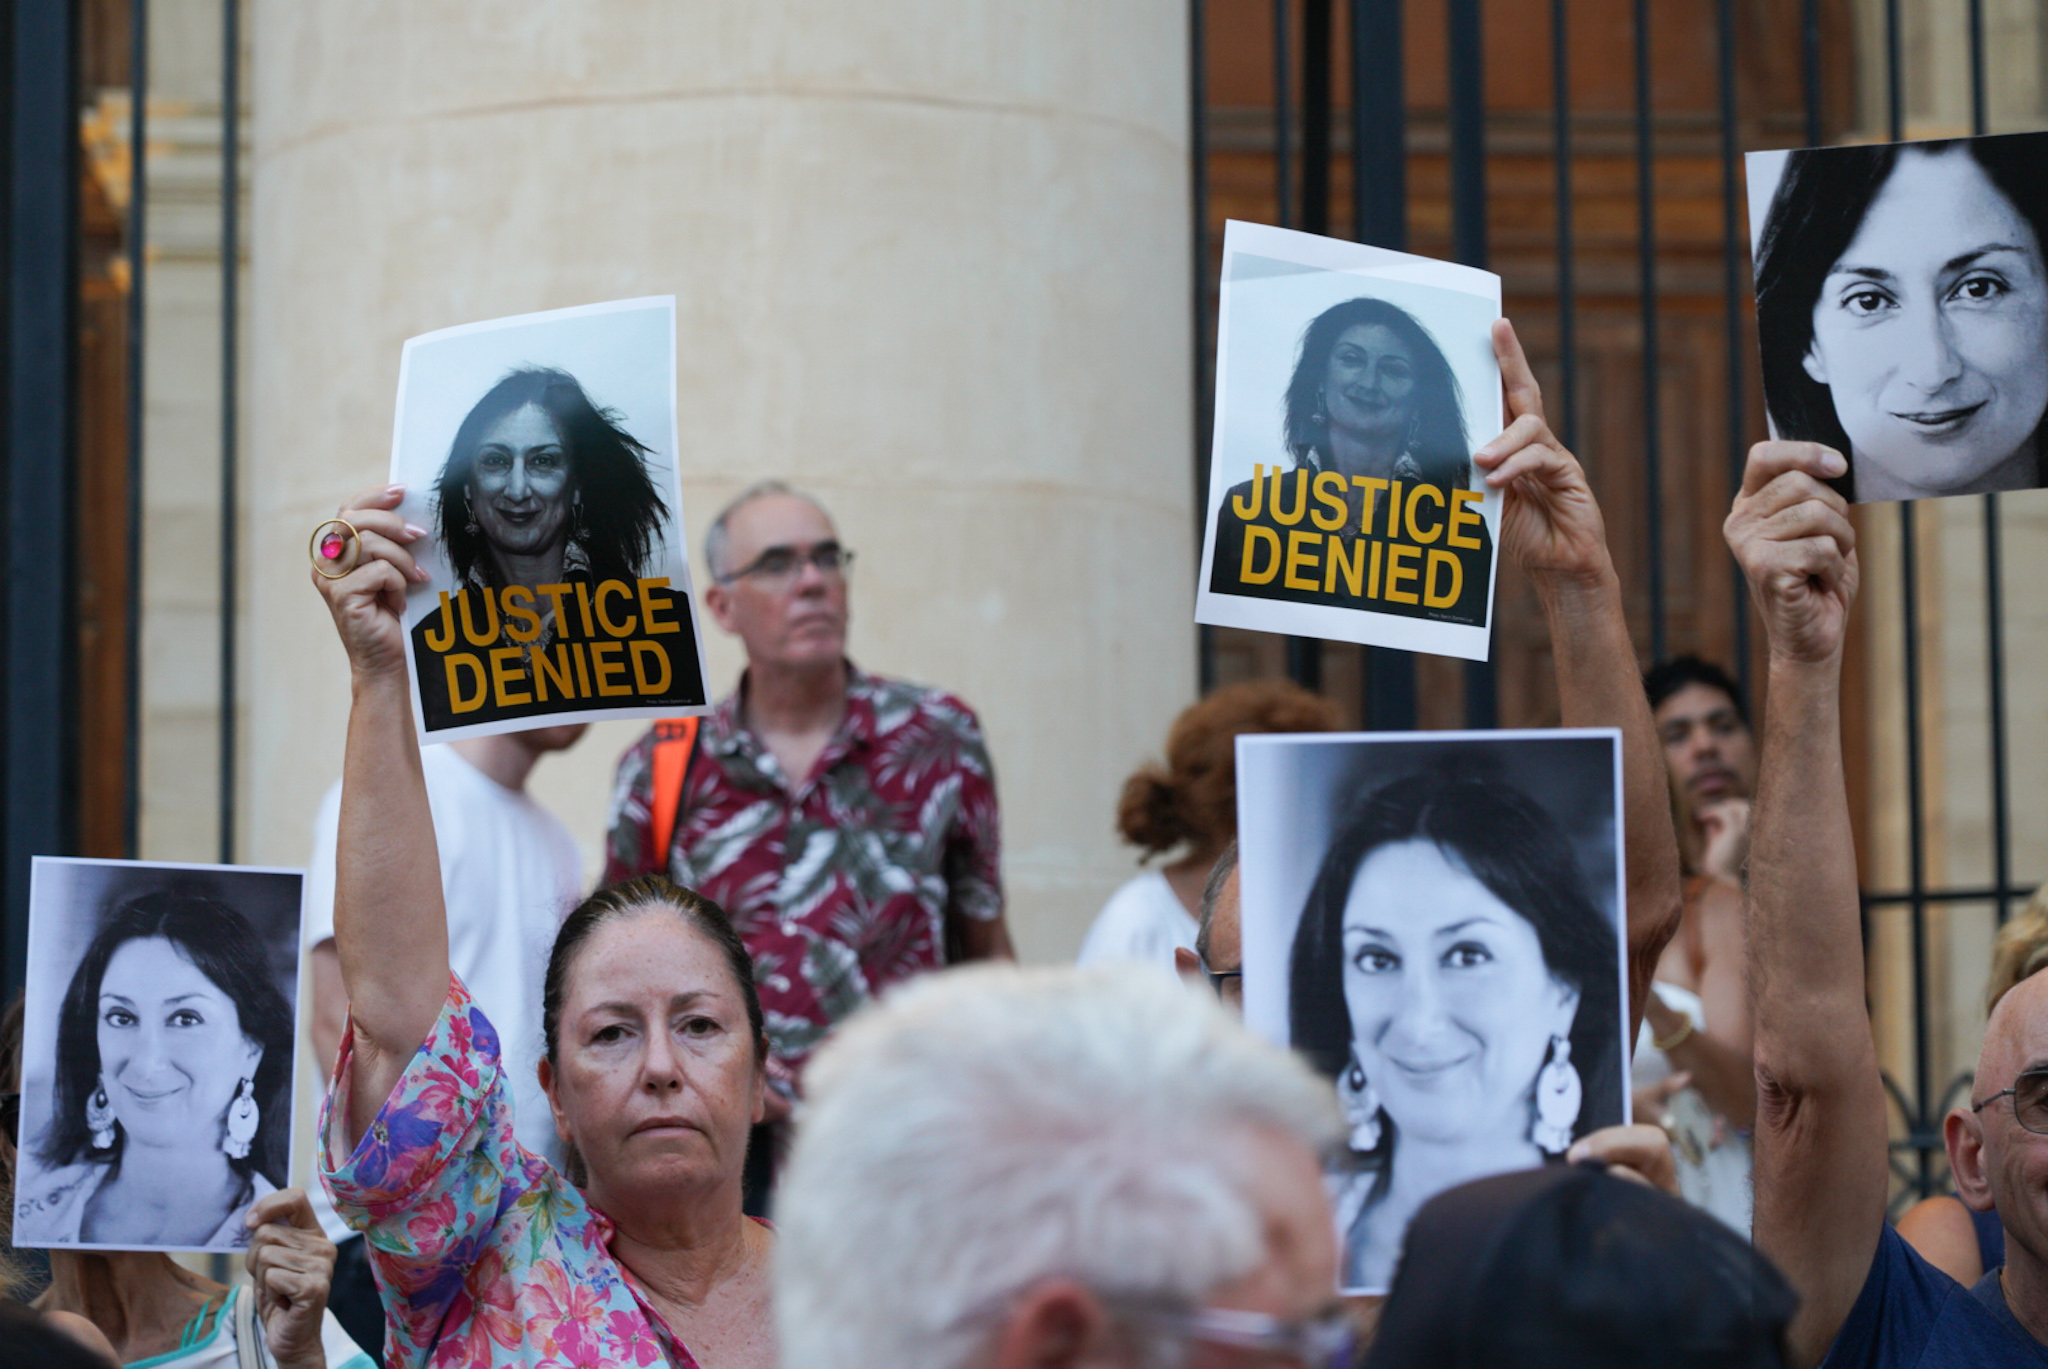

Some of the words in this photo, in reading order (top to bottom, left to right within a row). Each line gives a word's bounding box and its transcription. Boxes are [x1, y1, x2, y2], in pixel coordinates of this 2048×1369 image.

[1232, 463, 1484, 550] JUSTICE
[1239, 523, 1464, 609] DENIED
[424, 577, 681, 653] JUSTICE
[443, 639, 672, 714] DENIED
